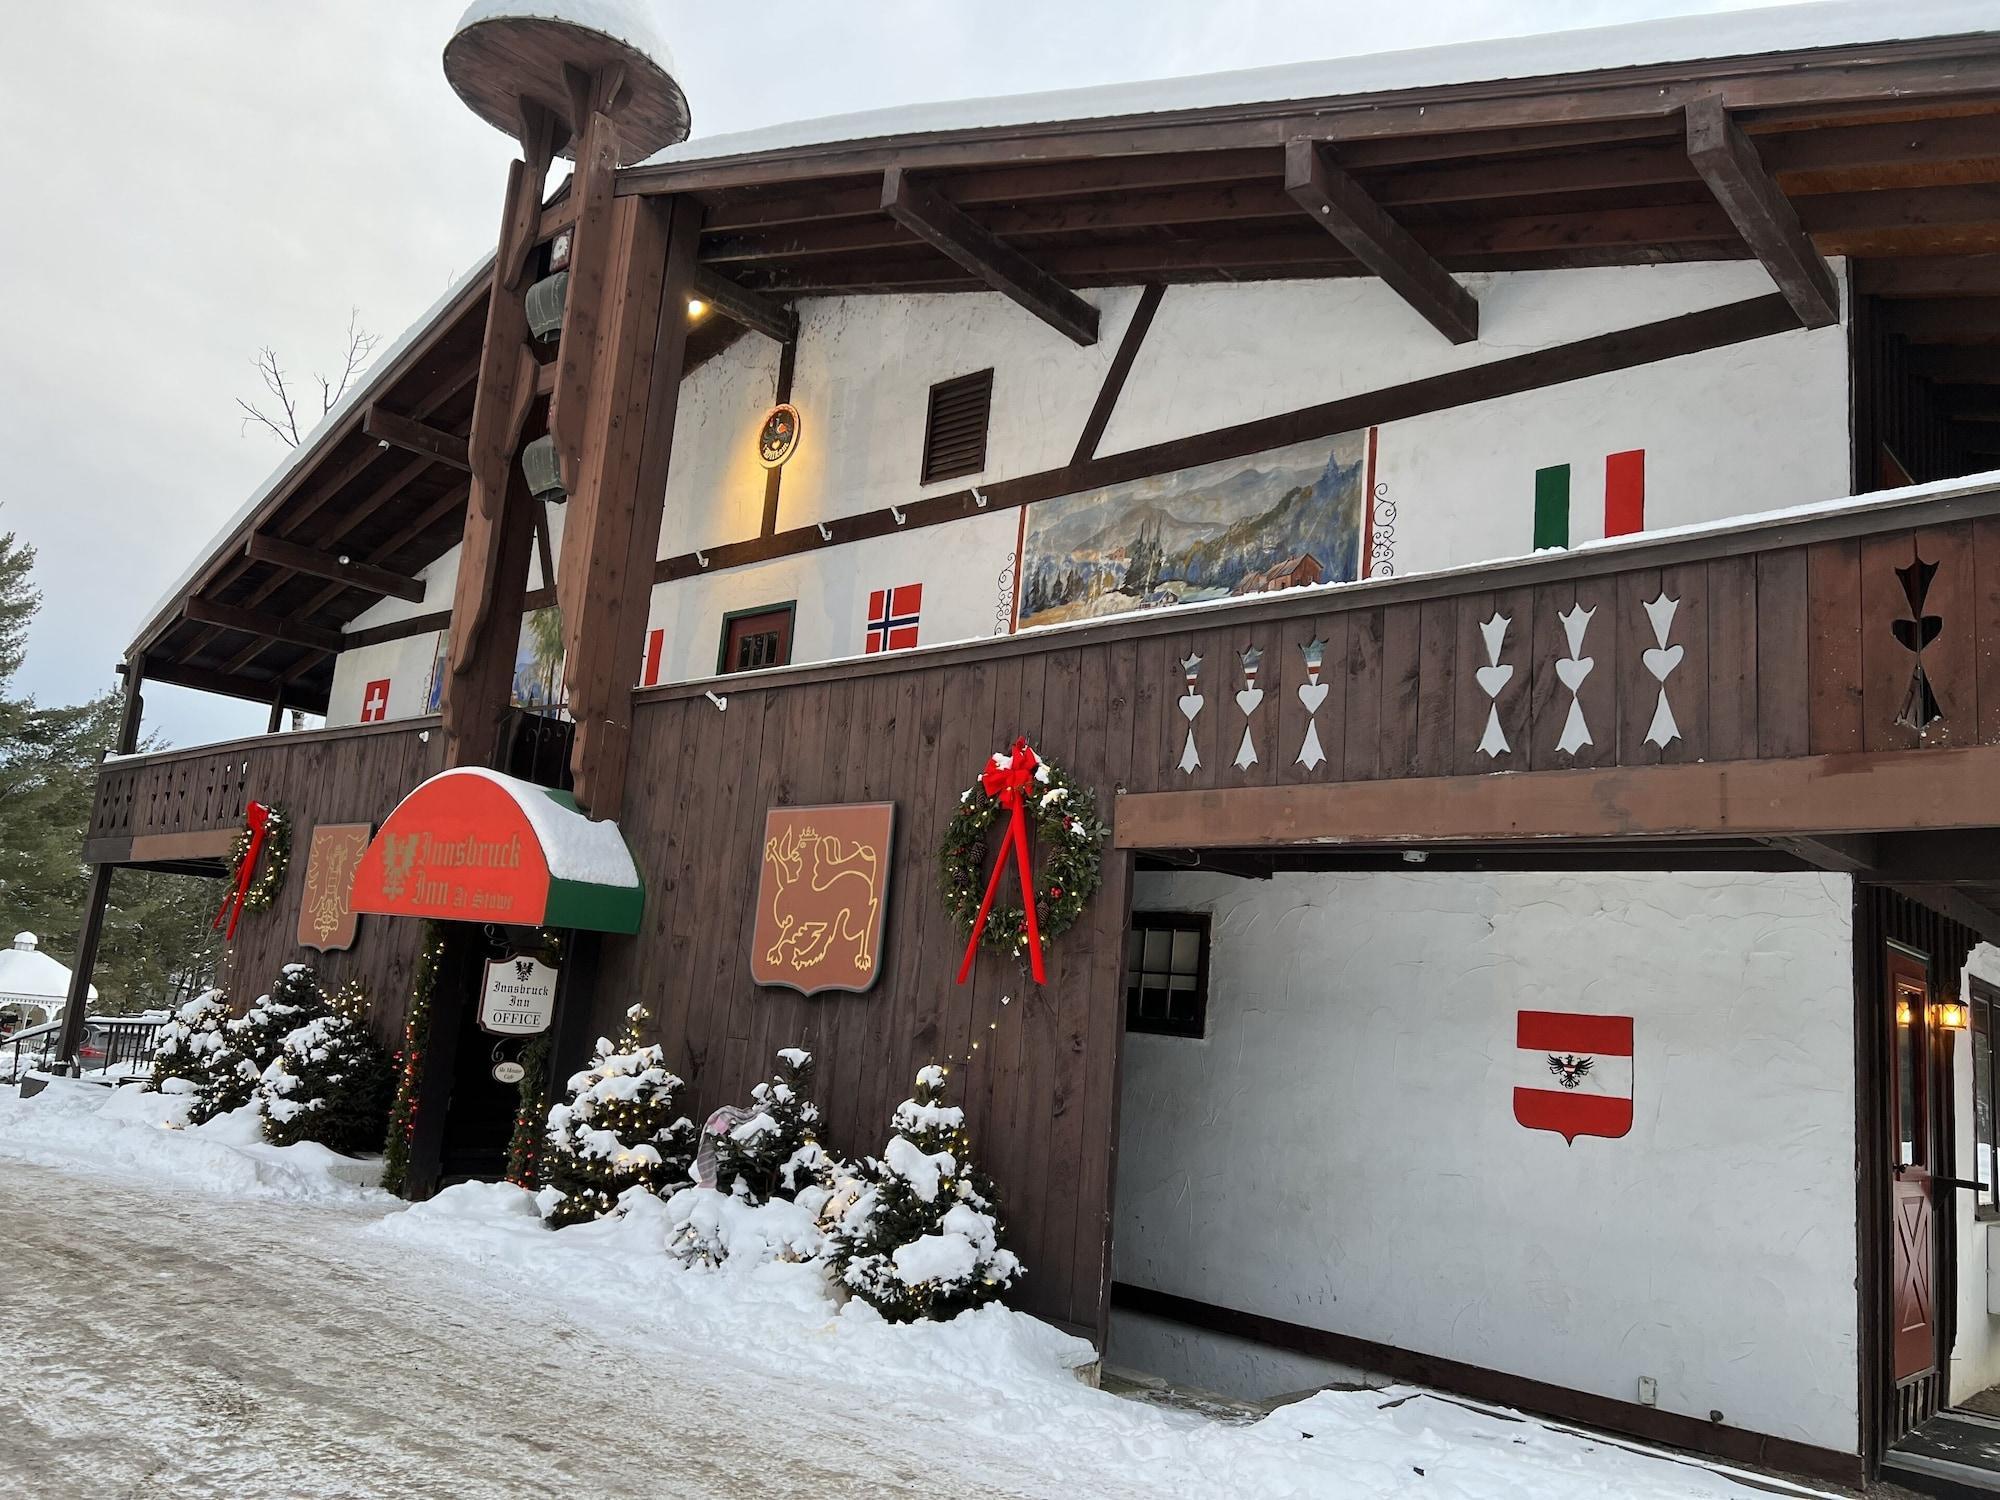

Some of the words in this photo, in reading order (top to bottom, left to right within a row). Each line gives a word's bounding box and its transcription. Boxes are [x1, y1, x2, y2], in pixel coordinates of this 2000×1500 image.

[417, 832, 520, 868] Innsbruck
[412, 871, 447, 905] Inn
[472, 889, 513, 911] Stowe
[492, 980, 549, 996] Innsbruck
[508, 995, 530, 1008] Inn
[492, 1012, 541, 1026] OFFICE
